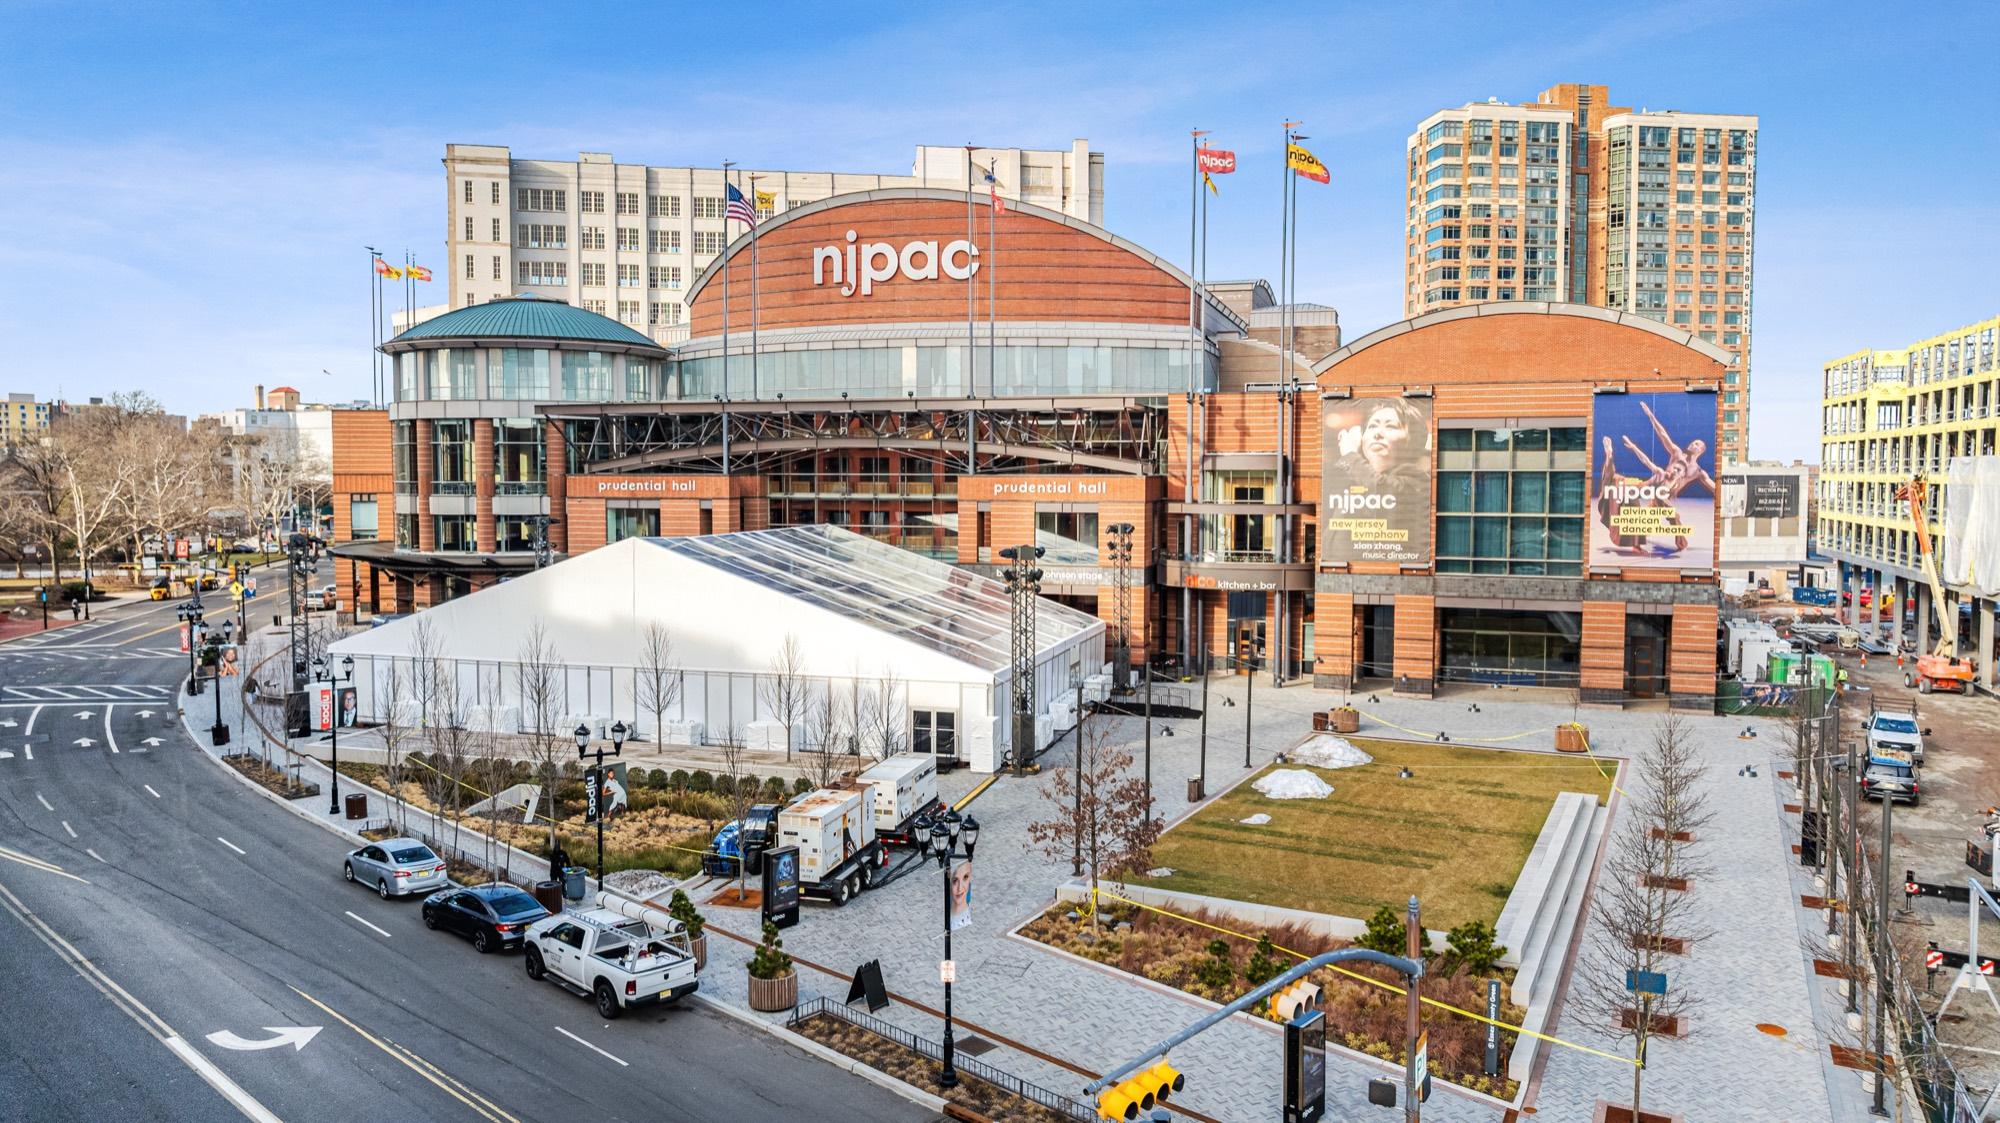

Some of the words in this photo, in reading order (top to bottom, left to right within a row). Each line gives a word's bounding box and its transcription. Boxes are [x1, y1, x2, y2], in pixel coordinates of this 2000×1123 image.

[1199, 154, 1233, 167] njpac
[813, 230, 980, 297] njpac
[598, 480, 666, 492] prudential
[672, 480, 695, 491] hall
[994, 481, 1071, 495] prudential
[1078, 481, 1106, 493] hall
[1603, 481, 1671, 504] njpac
[1329, 489, 1396, 514] njpac
[1649, 508, 1674, 516] ailey
[1354, 520, 1385, 530] jersey
[1655, 526, 1691, 534] theater
[1353, 531, 1406, 540] symphony
[1353, 542, 1372, 550] xian
[1387, 551, 1420, 560] director
[1217, 580, 1251, 589] kitchen
[1260, 581, 1277, 589] bar
[585, 775, 596, 816] njpac
[1489, 984, 1497, 1003] Green
